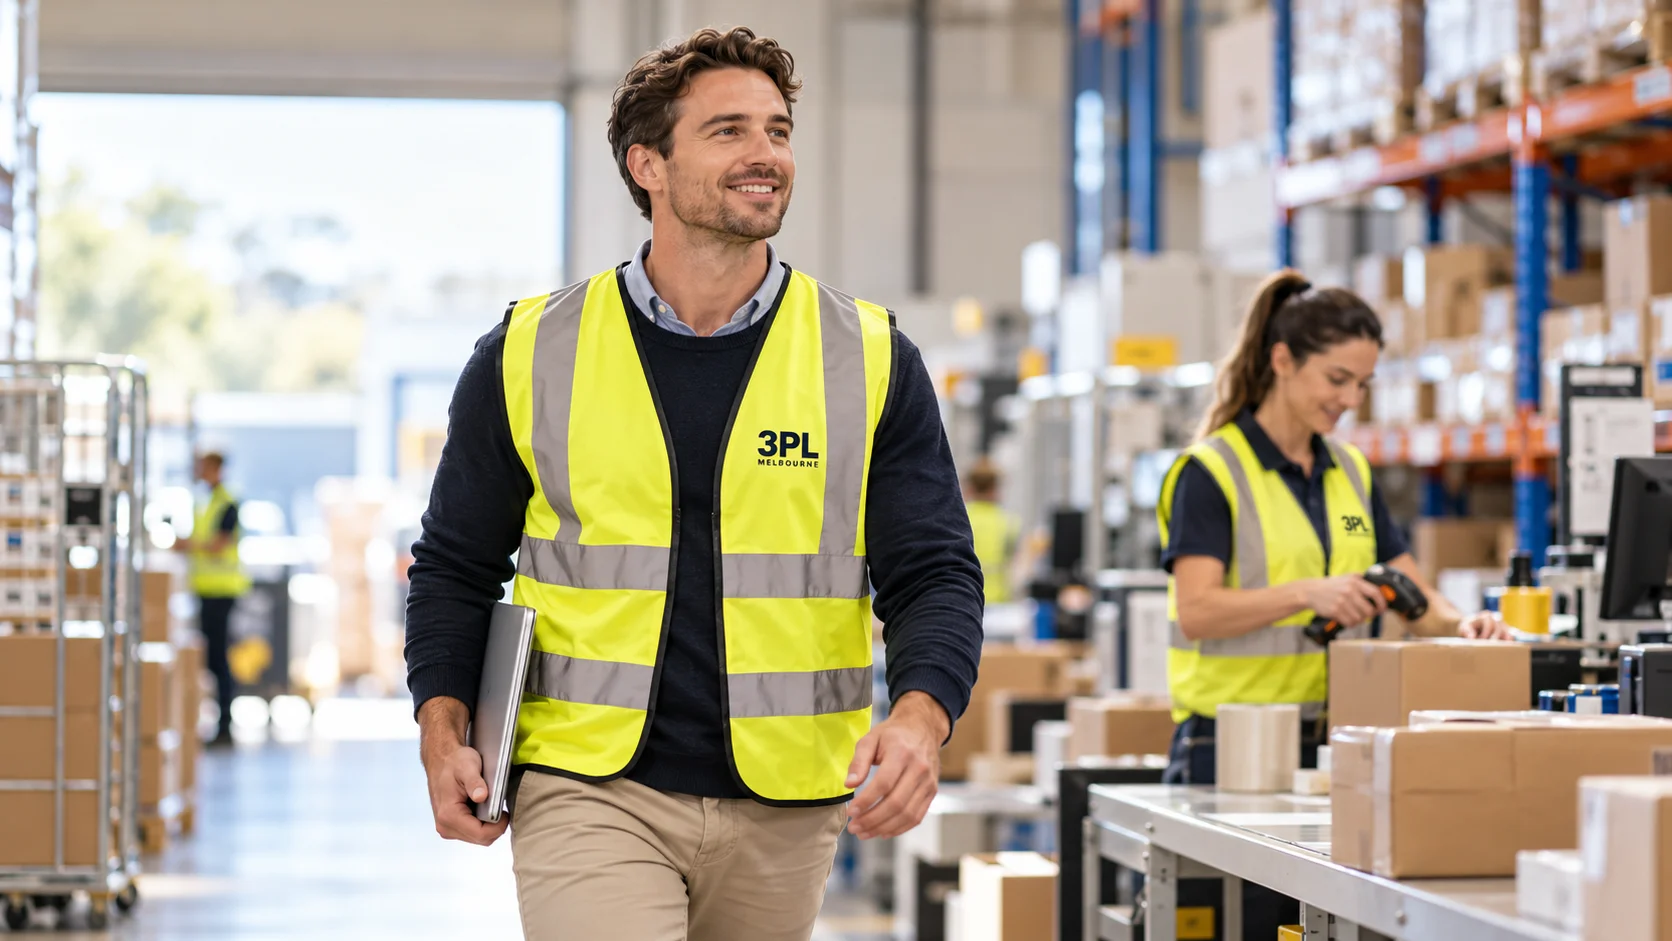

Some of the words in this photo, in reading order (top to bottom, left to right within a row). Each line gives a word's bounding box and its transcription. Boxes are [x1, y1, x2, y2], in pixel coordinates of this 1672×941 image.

[757, 430, 819, 459] 3PL
[757, 459, 819, 468] MELBOURNE
[1341, 515, 1368, 532] 3PL
